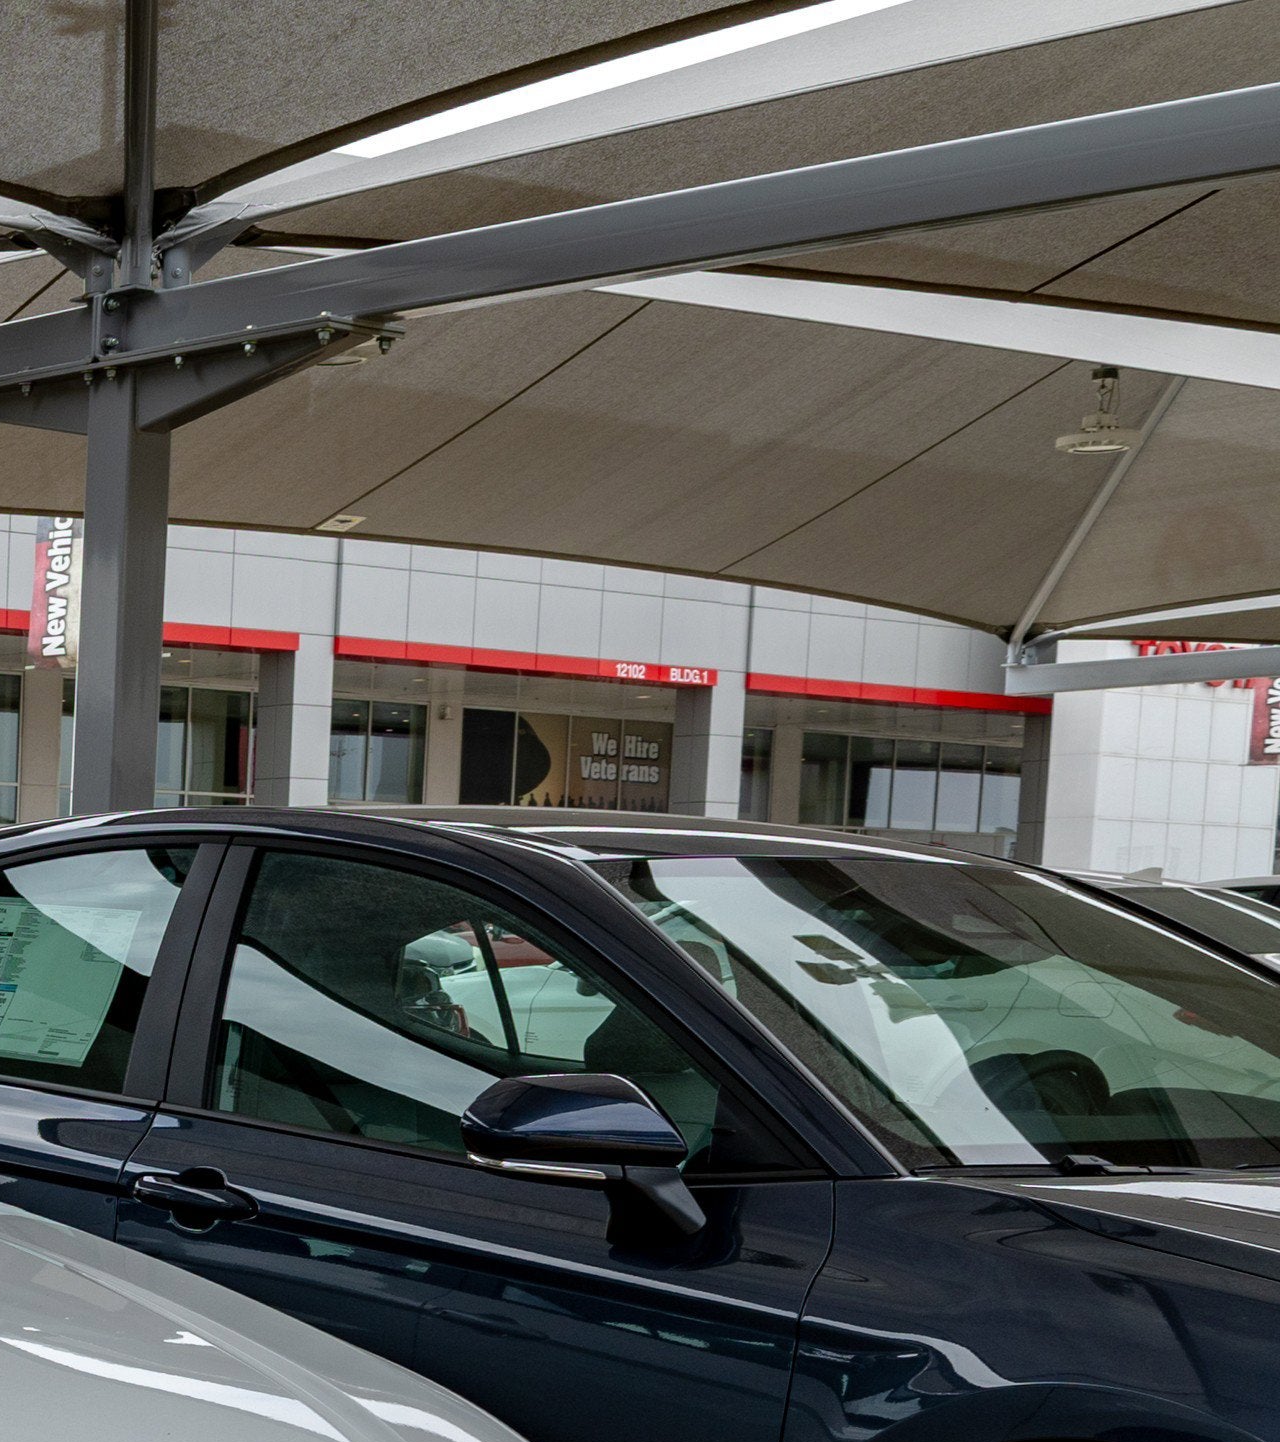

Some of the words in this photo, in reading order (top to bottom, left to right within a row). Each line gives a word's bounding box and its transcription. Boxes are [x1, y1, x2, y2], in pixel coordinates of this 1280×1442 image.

[42, 596, 67, 657] New
[615, 662, 646, 679] 12102
[591, 732, 618, 757] We
[625, 735, 660, 760] Hire
[580, 756, 660, 783] Veterans
